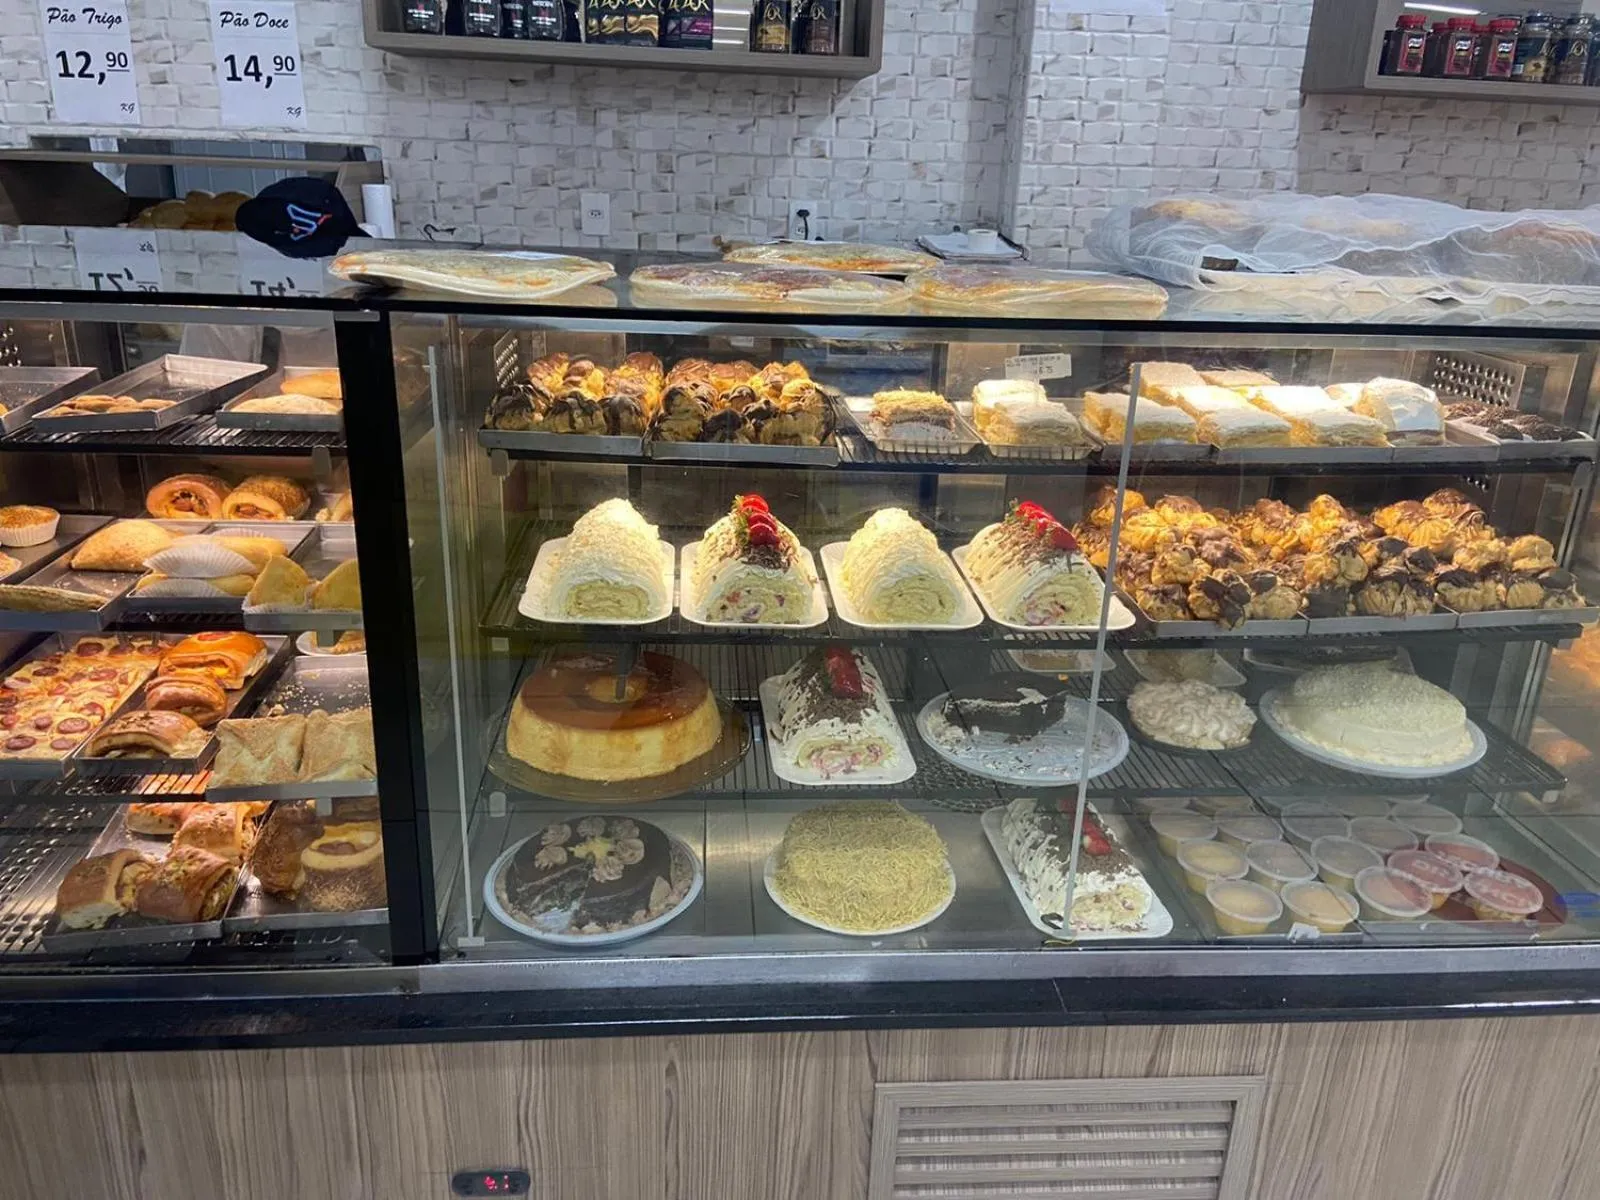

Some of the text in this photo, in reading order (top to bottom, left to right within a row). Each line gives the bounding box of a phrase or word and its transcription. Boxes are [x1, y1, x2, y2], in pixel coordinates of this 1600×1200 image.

[47, 7, 123, 29] Pão Trigo
[219, 11, 289, 28] Pão Doce
